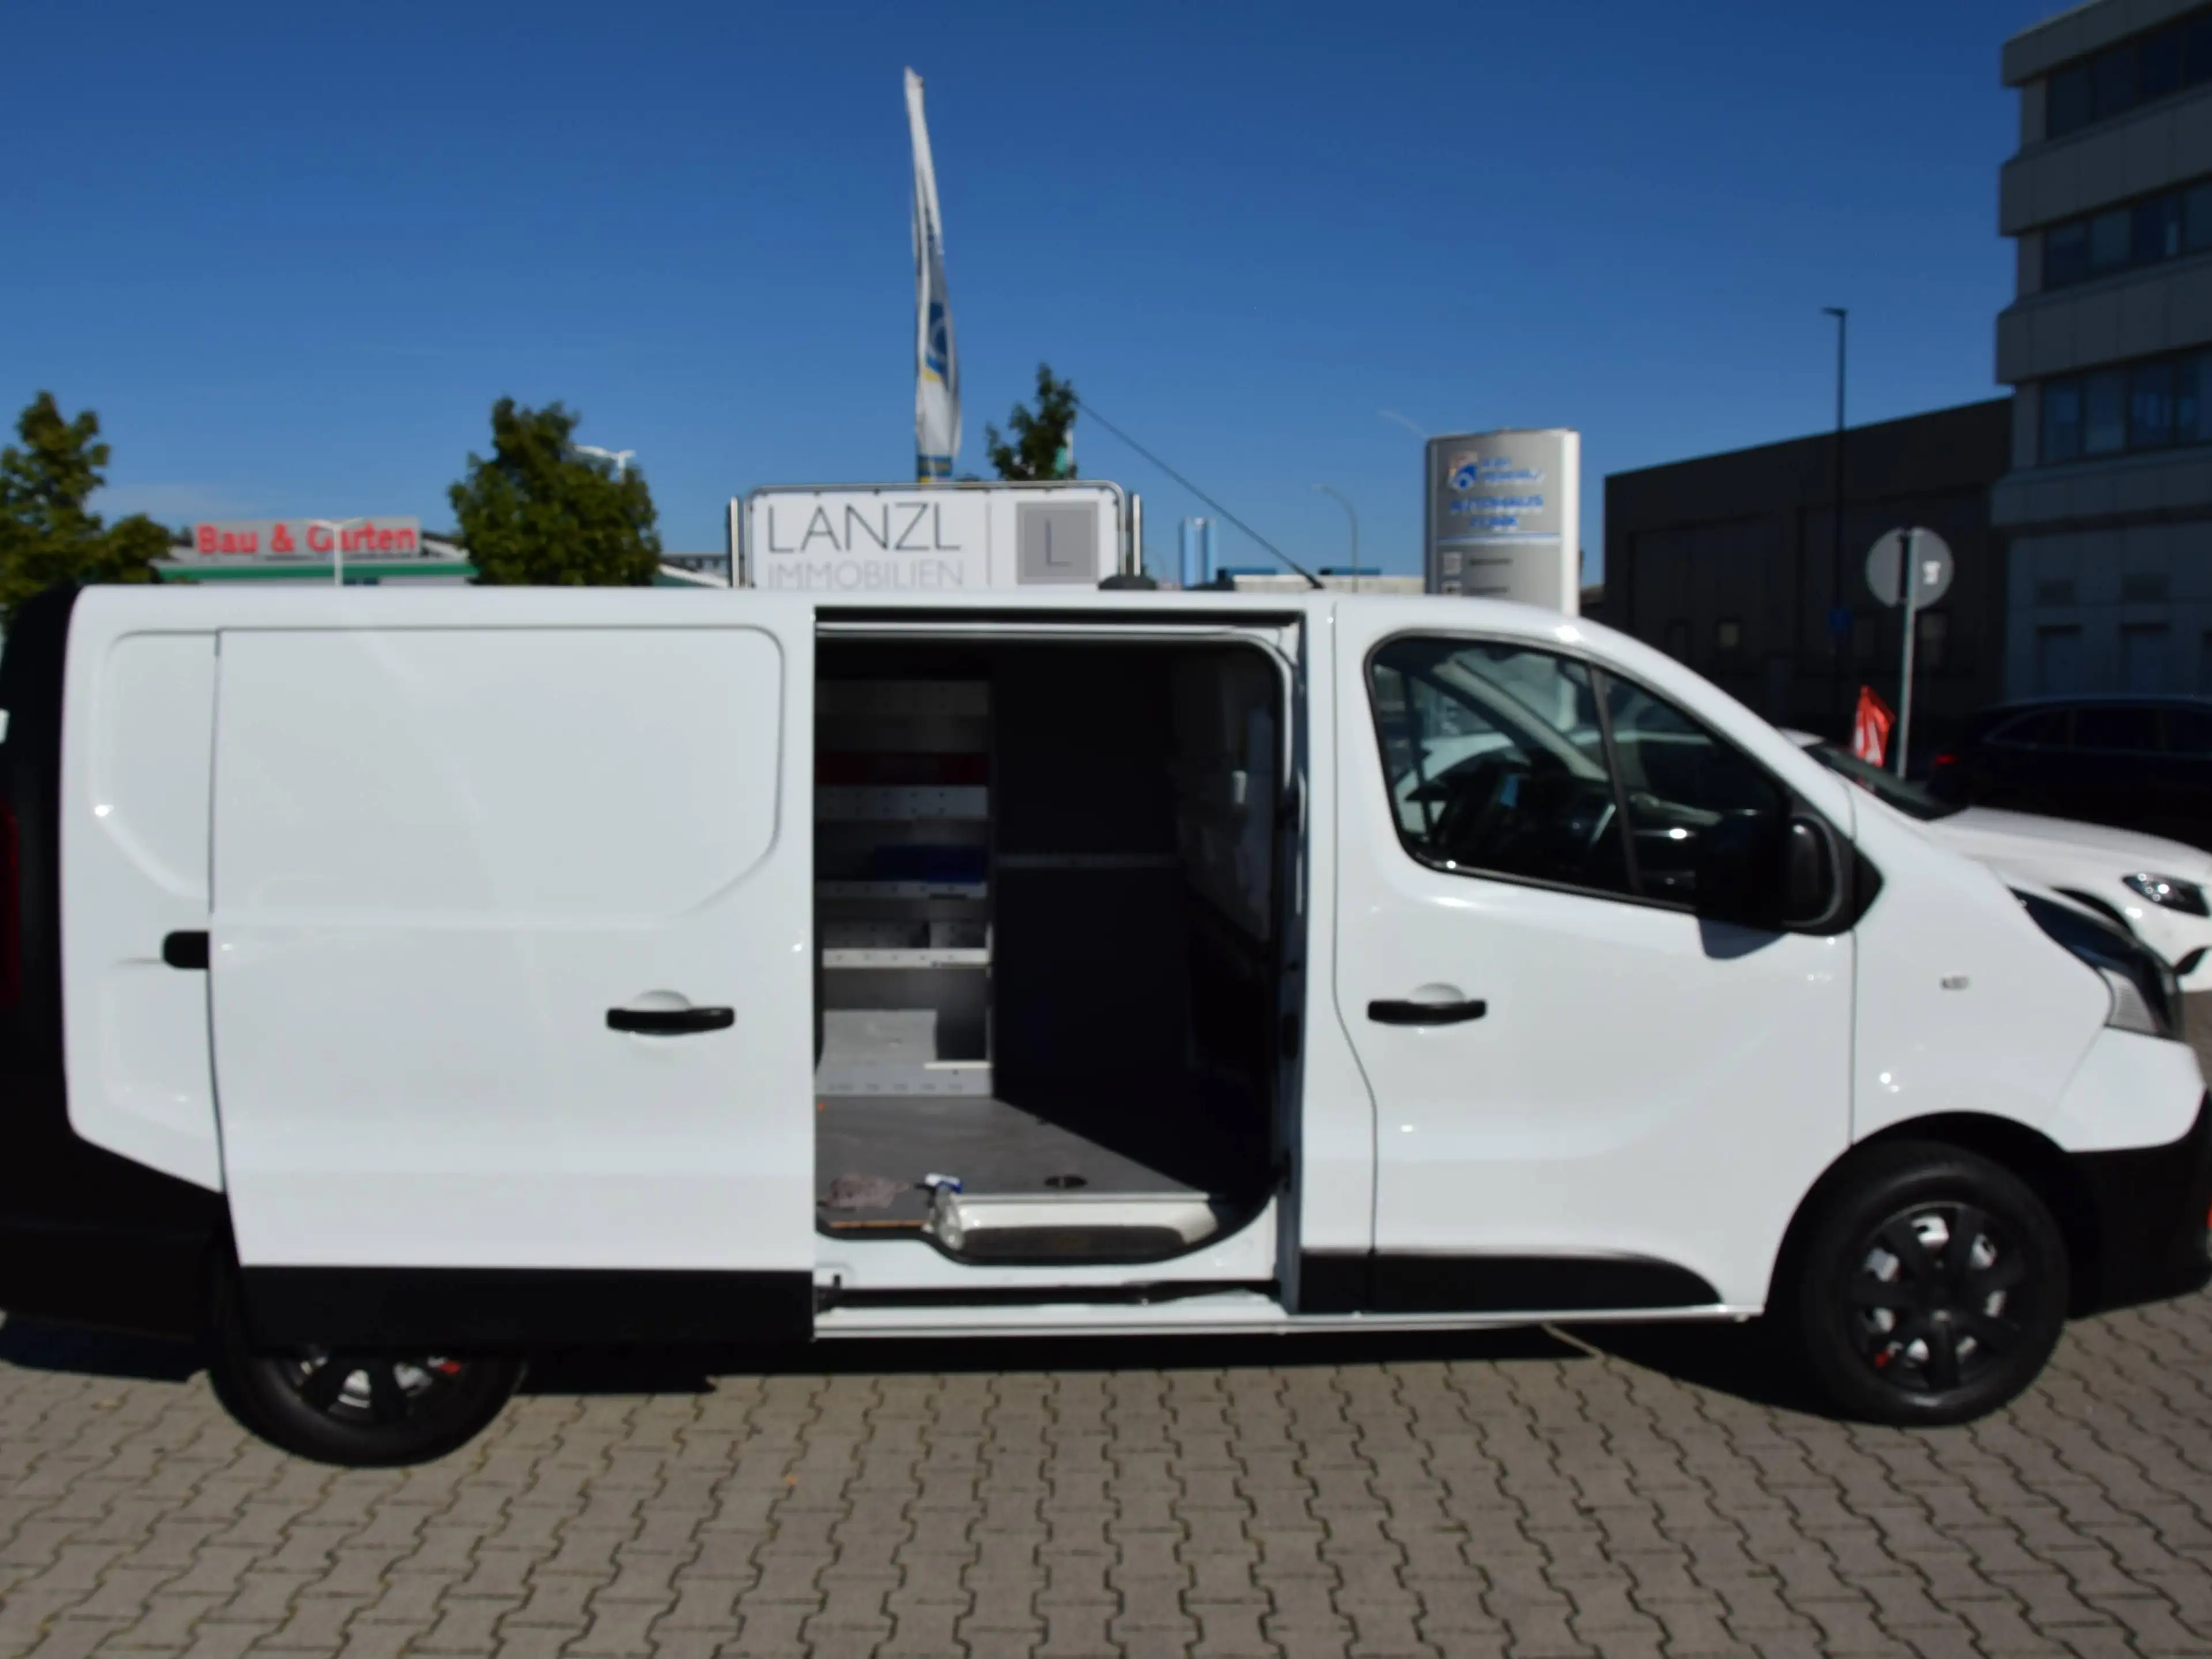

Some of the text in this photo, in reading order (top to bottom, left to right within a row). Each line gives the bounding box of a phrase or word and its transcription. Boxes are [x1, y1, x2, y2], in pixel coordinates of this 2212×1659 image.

[197, 521, 417, 554] Bau & Garten
[767, 502, 961, 552] LANZL
[1045, 521, 1072, 567] L
[768, 559, 965, 590] IMMOBILIEN
